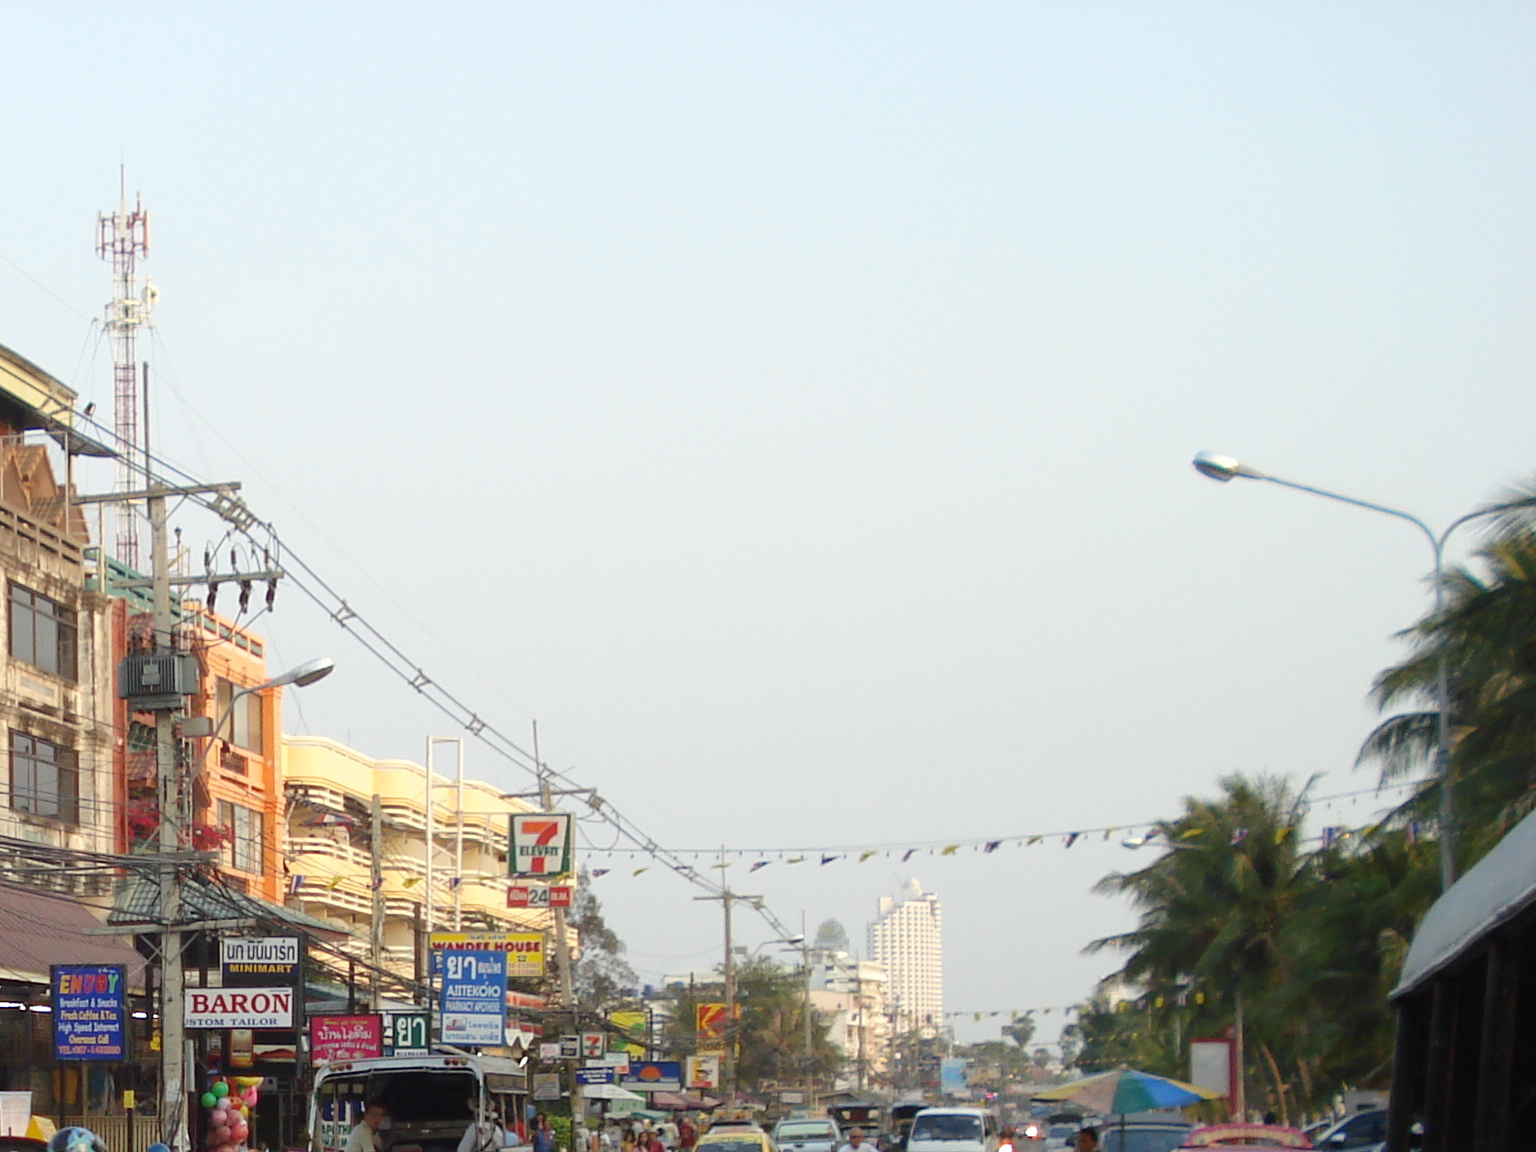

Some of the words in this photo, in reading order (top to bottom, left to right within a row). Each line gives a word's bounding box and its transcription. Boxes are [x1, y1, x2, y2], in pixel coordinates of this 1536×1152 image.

[529, 889, 548, 904] 24
[432, 941, 490, 951] WANDEE
[495, 941, 540, 952] HOUSE
[230, 964, 293, 973] MINIMART
[447, 956, 476, 980] ยา
[59, 973, 119, 994] ENJOY
[60, 998, 89, 1008] Breakfast
[191, 993, 290, 1014] BARON
[230, 1018, 278, 1026] TAILOR
[397, 1017, 426, 1046] ยา
